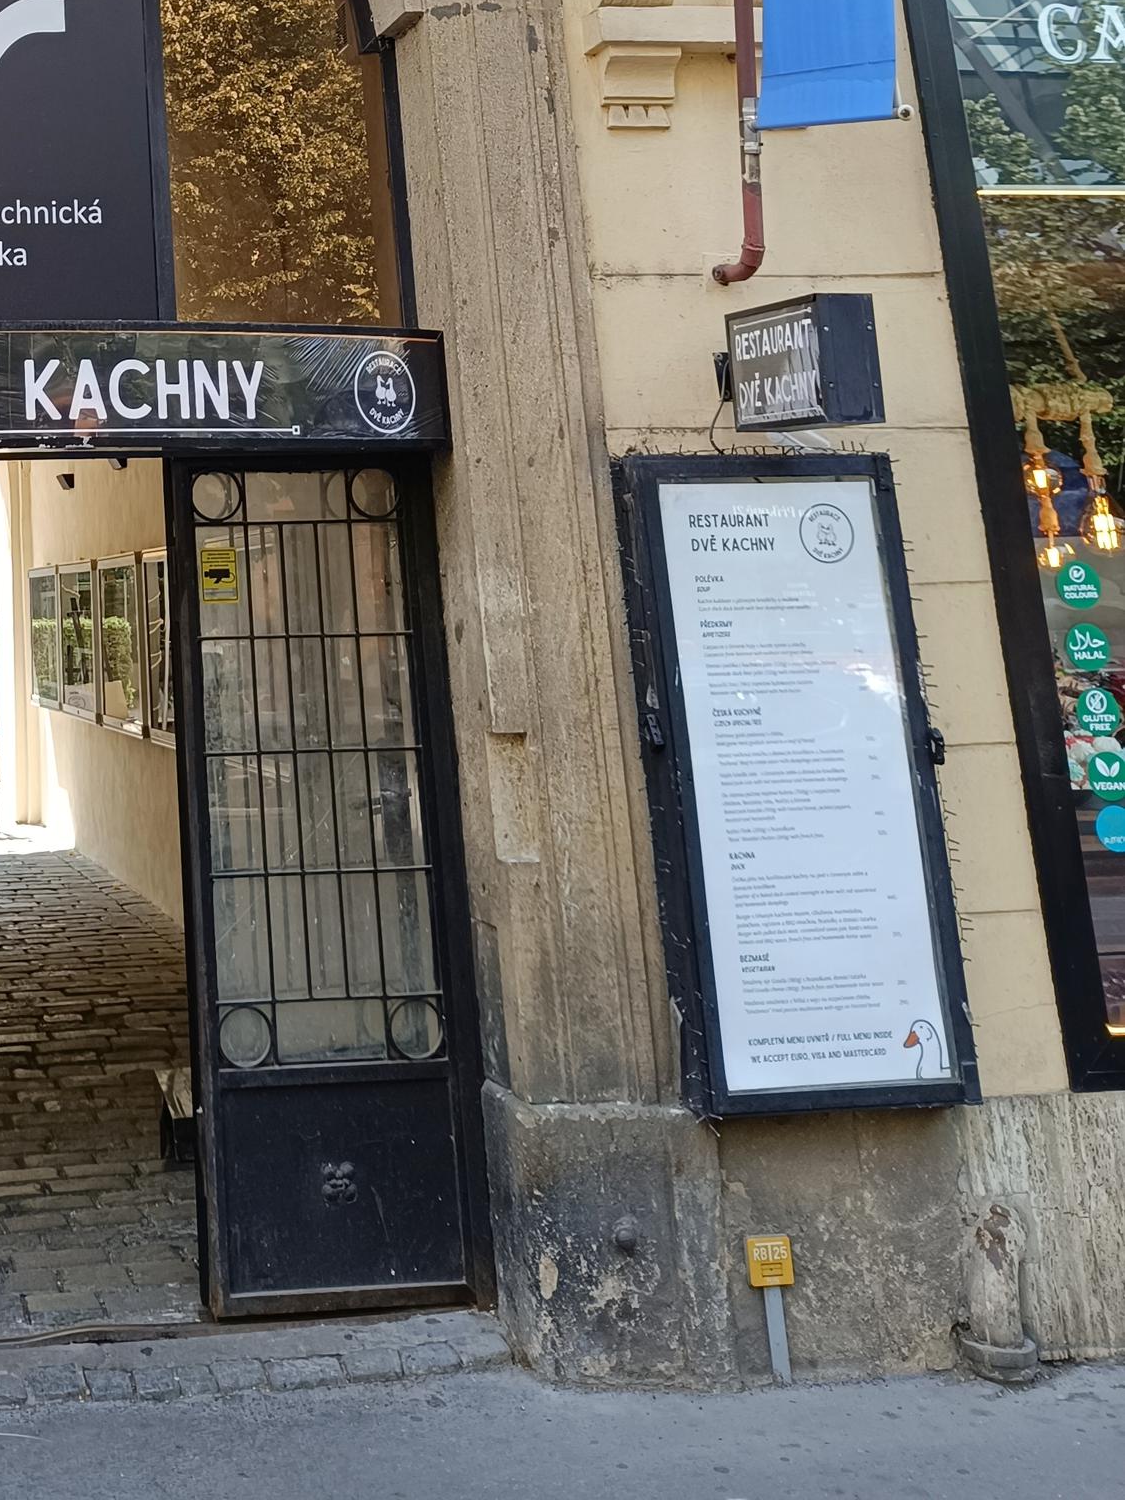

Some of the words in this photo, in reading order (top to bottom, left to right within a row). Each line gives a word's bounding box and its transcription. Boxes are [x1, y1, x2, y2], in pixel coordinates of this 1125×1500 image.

[734, 318, 812, 361] RESTAURANT
[366, 357, 405, 376] RESTAURACE
[23, 358, 265, 421] KACHNY
[738, 372, 762, 409] DVĚ
[764, 369, 817, 405] KACHNY
[688, 513, 770, 528] RESTAURANT
[691, 534, 718, 552] DVĚ
[722, 537, 775, 551] KACHNY
[1063, 584, 1097, 592] NATURAL
[1065, 591, 1099, 600] COLOURS
[1069, 628, 1106, 651] حلال
[1073, 651, 1107, 660] HALAL
[1083, 714, 1116, 723] GLUTEN
[1089, 723, 1112, 731] FREE
[1093, 782, 1125, 791] VEGAN
